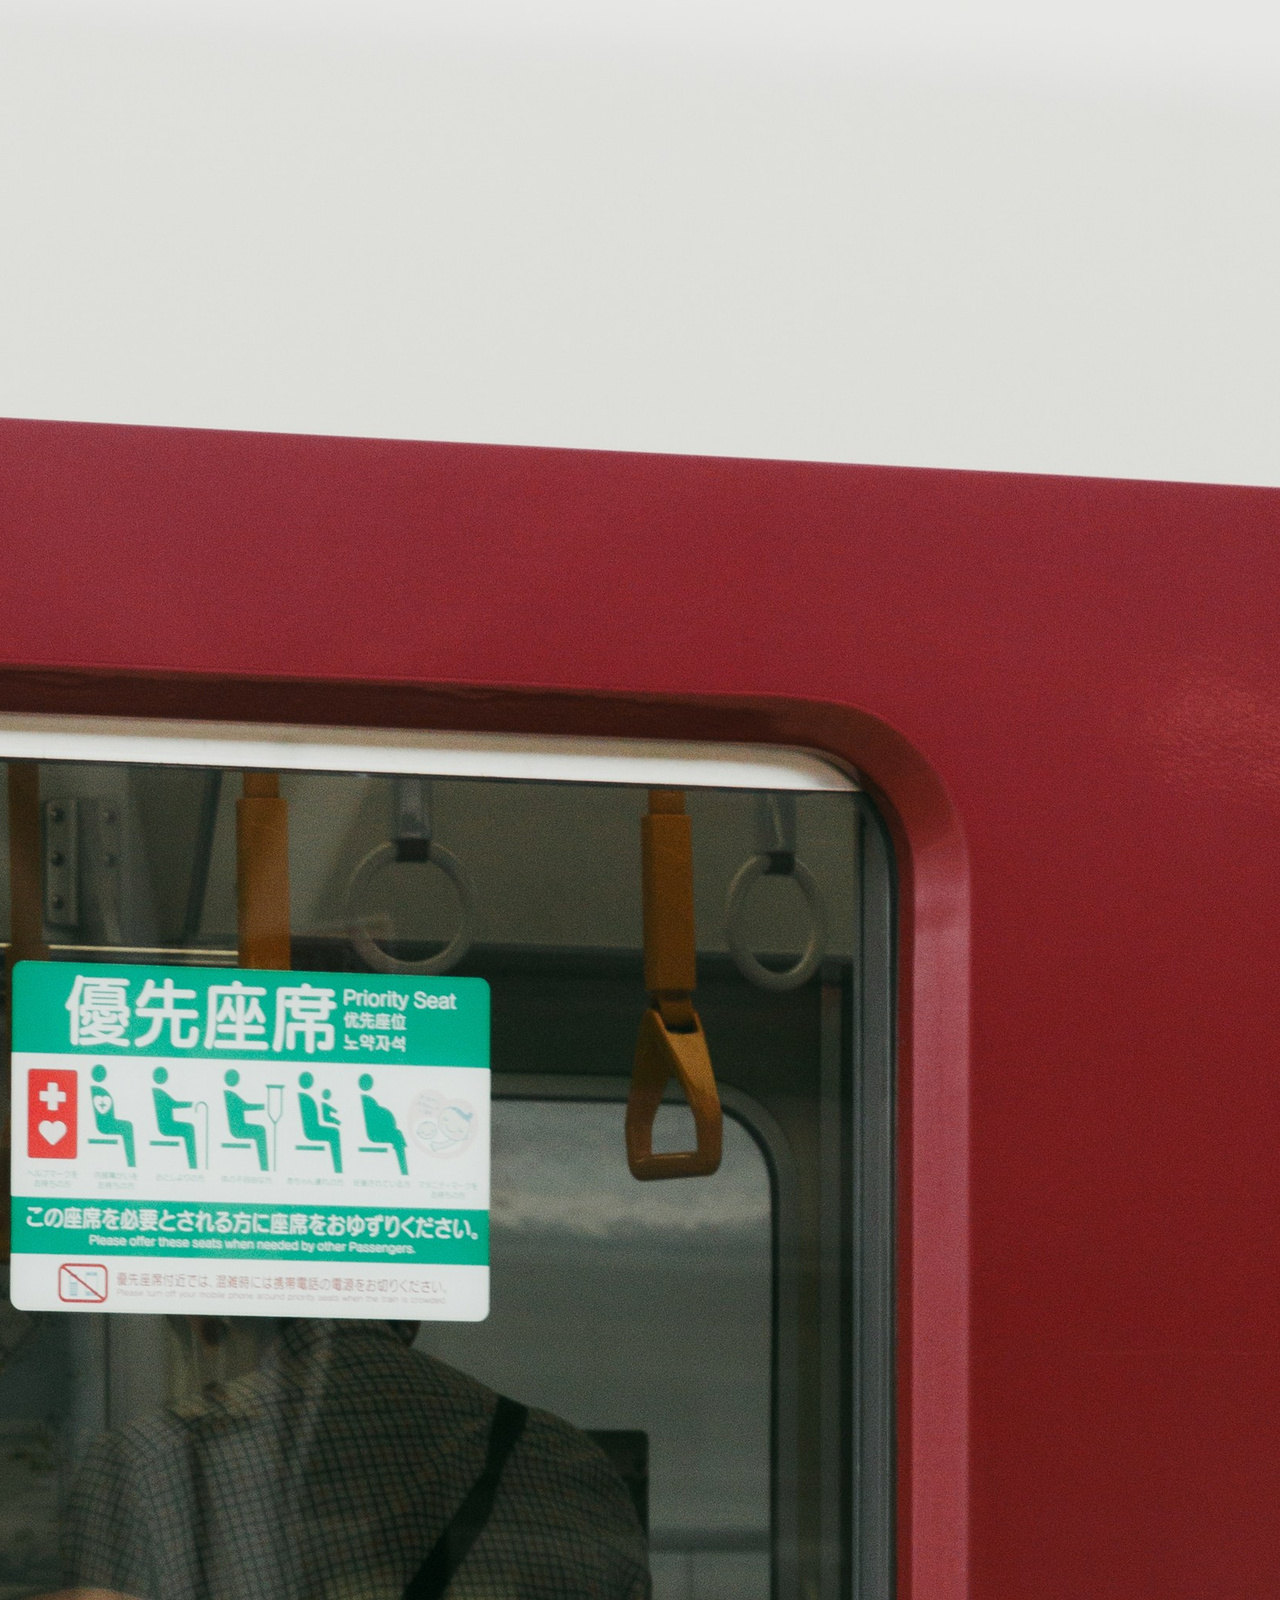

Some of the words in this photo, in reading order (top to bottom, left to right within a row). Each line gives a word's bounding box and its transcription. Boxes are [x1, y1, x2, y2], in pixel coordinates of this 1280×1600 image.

[343, 988, 409, 1011] Priority
[413, 991, 458, 1010] Seat
[65, 974, 338, 1054] 優先座席
[343, 1012, 407, 1031] 优先座位
[343, 1034, 407, 1053] 노약자석
[26, 1206, 479, 1240] この座席を必要とされる方に座席をおゆずりください。
[88, 1234, 127, 1246] Please
[129, 1235, 156, 1247] offer
[158, 1236, 190, 1248] these
[192, 1238, 222, 1249] seats
[225, 1239, 254, 1250] when
[257, 1240, 299, 1251] needed
[301, 1241, 315, 1253] by
[318, 1241, 346, 1252] other
[348, 1242, 416, 1255] Passengers.
[116, 1271, 448, 1294] 優先座席付近では、混雑時には携帯電話の電源をお切りください。
[116, 1288, 144, 1297] Please
[179, 1291, 196, 1299] your
[199, 1291, 225, 1299] mobile
[228, 1292, 253, 1300] phone
[287, 1293, 315, 1302] priority
